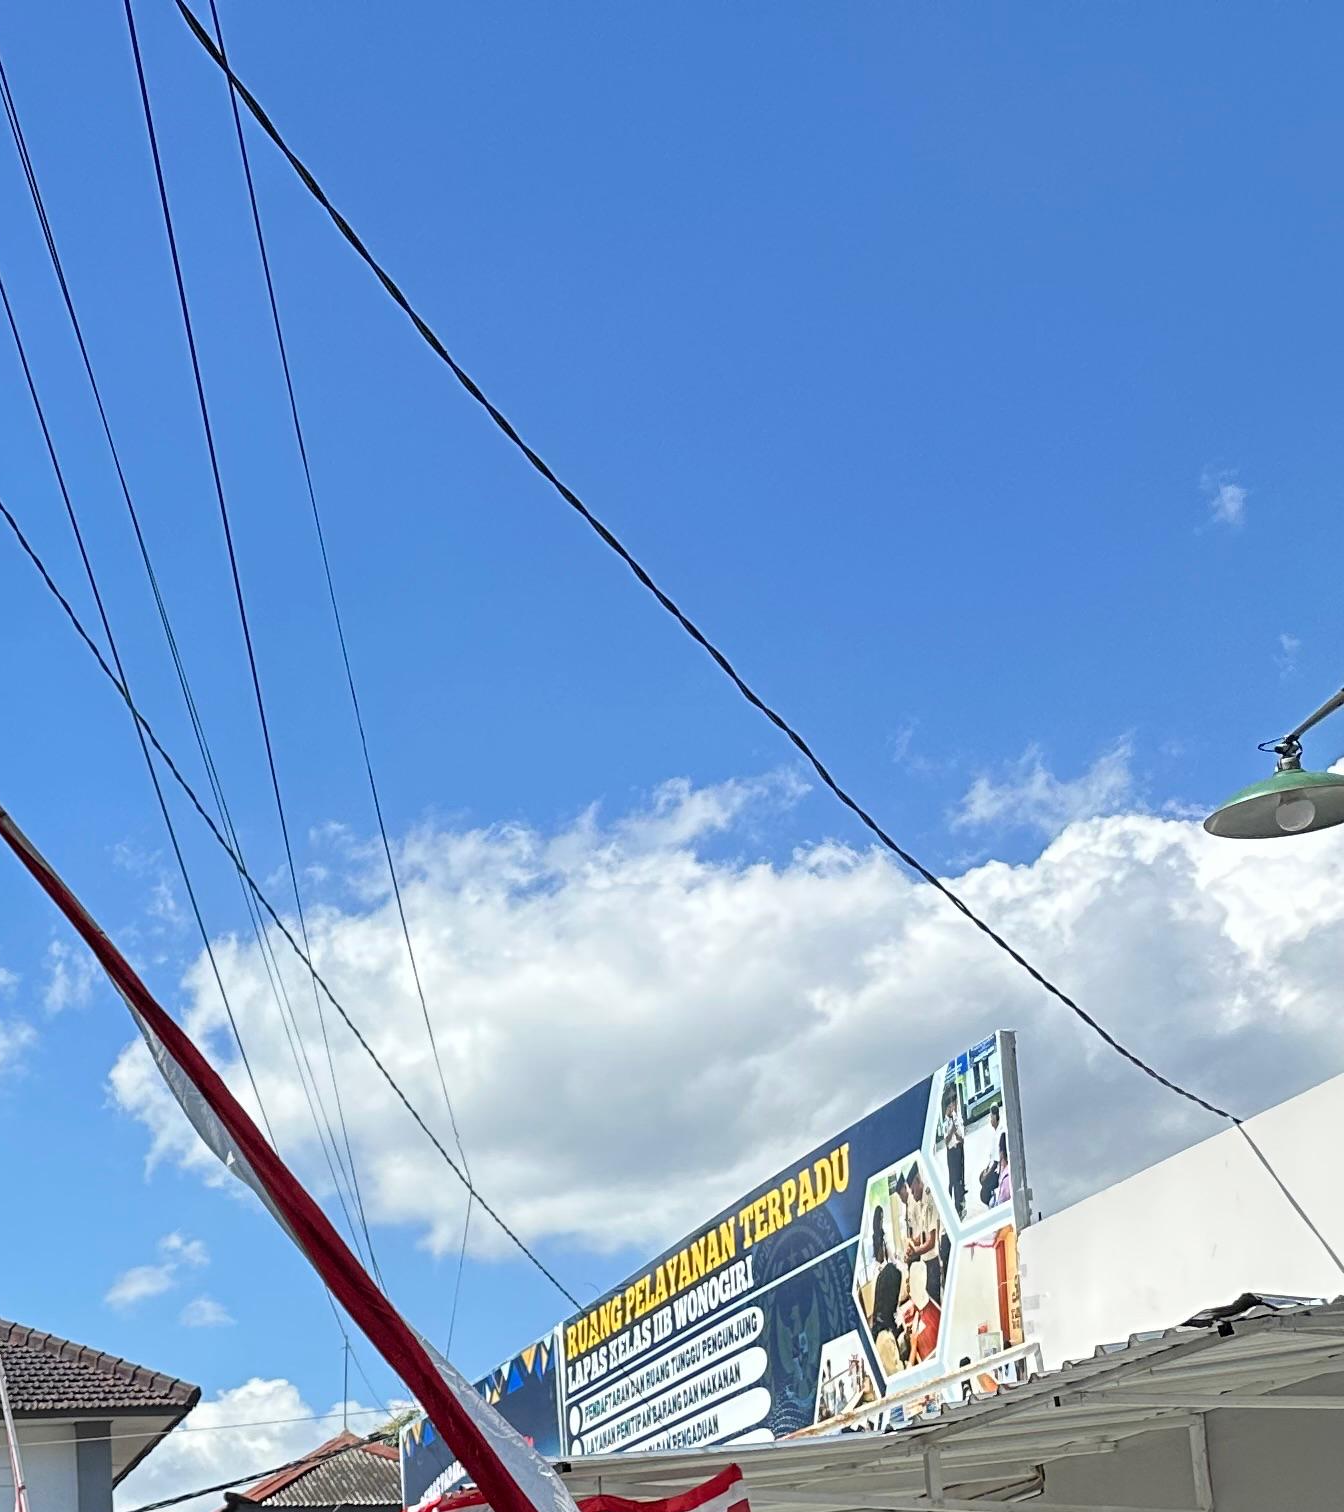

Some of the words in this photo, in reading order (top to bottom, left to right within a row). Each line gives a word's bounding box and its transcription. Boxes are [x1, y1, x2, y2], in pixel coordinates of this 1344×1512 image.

[566, 1294, 623, 1360] RUANG
[624, 1217, 736, 1324] PELAYANAN
[739, 1143, 849, 1249] TERPADU
[567, 1347, 608, 1391] LAPAS
[609, 1322, 652, 1367] KELAS
[652, 1307, 673, 1343] IIB
[673, 1255, 754, 1330] WONOGIRI
[584, 1378, 630, 1423] PENDAFTARAN
[646, 1362, 669, 1389] RUANG
[671, 1343, 700, 1376] TUNGGU
[702, 1312, 758, 1354] PENGUNJUNG
[585, 1425, 619, 1453] LAYANAN
[683, 1385, 699, 1408] DAN
[700, 1361, 741, 1396] MAKANAN
[672, 1414, 719, 1450] PENGADUAN
